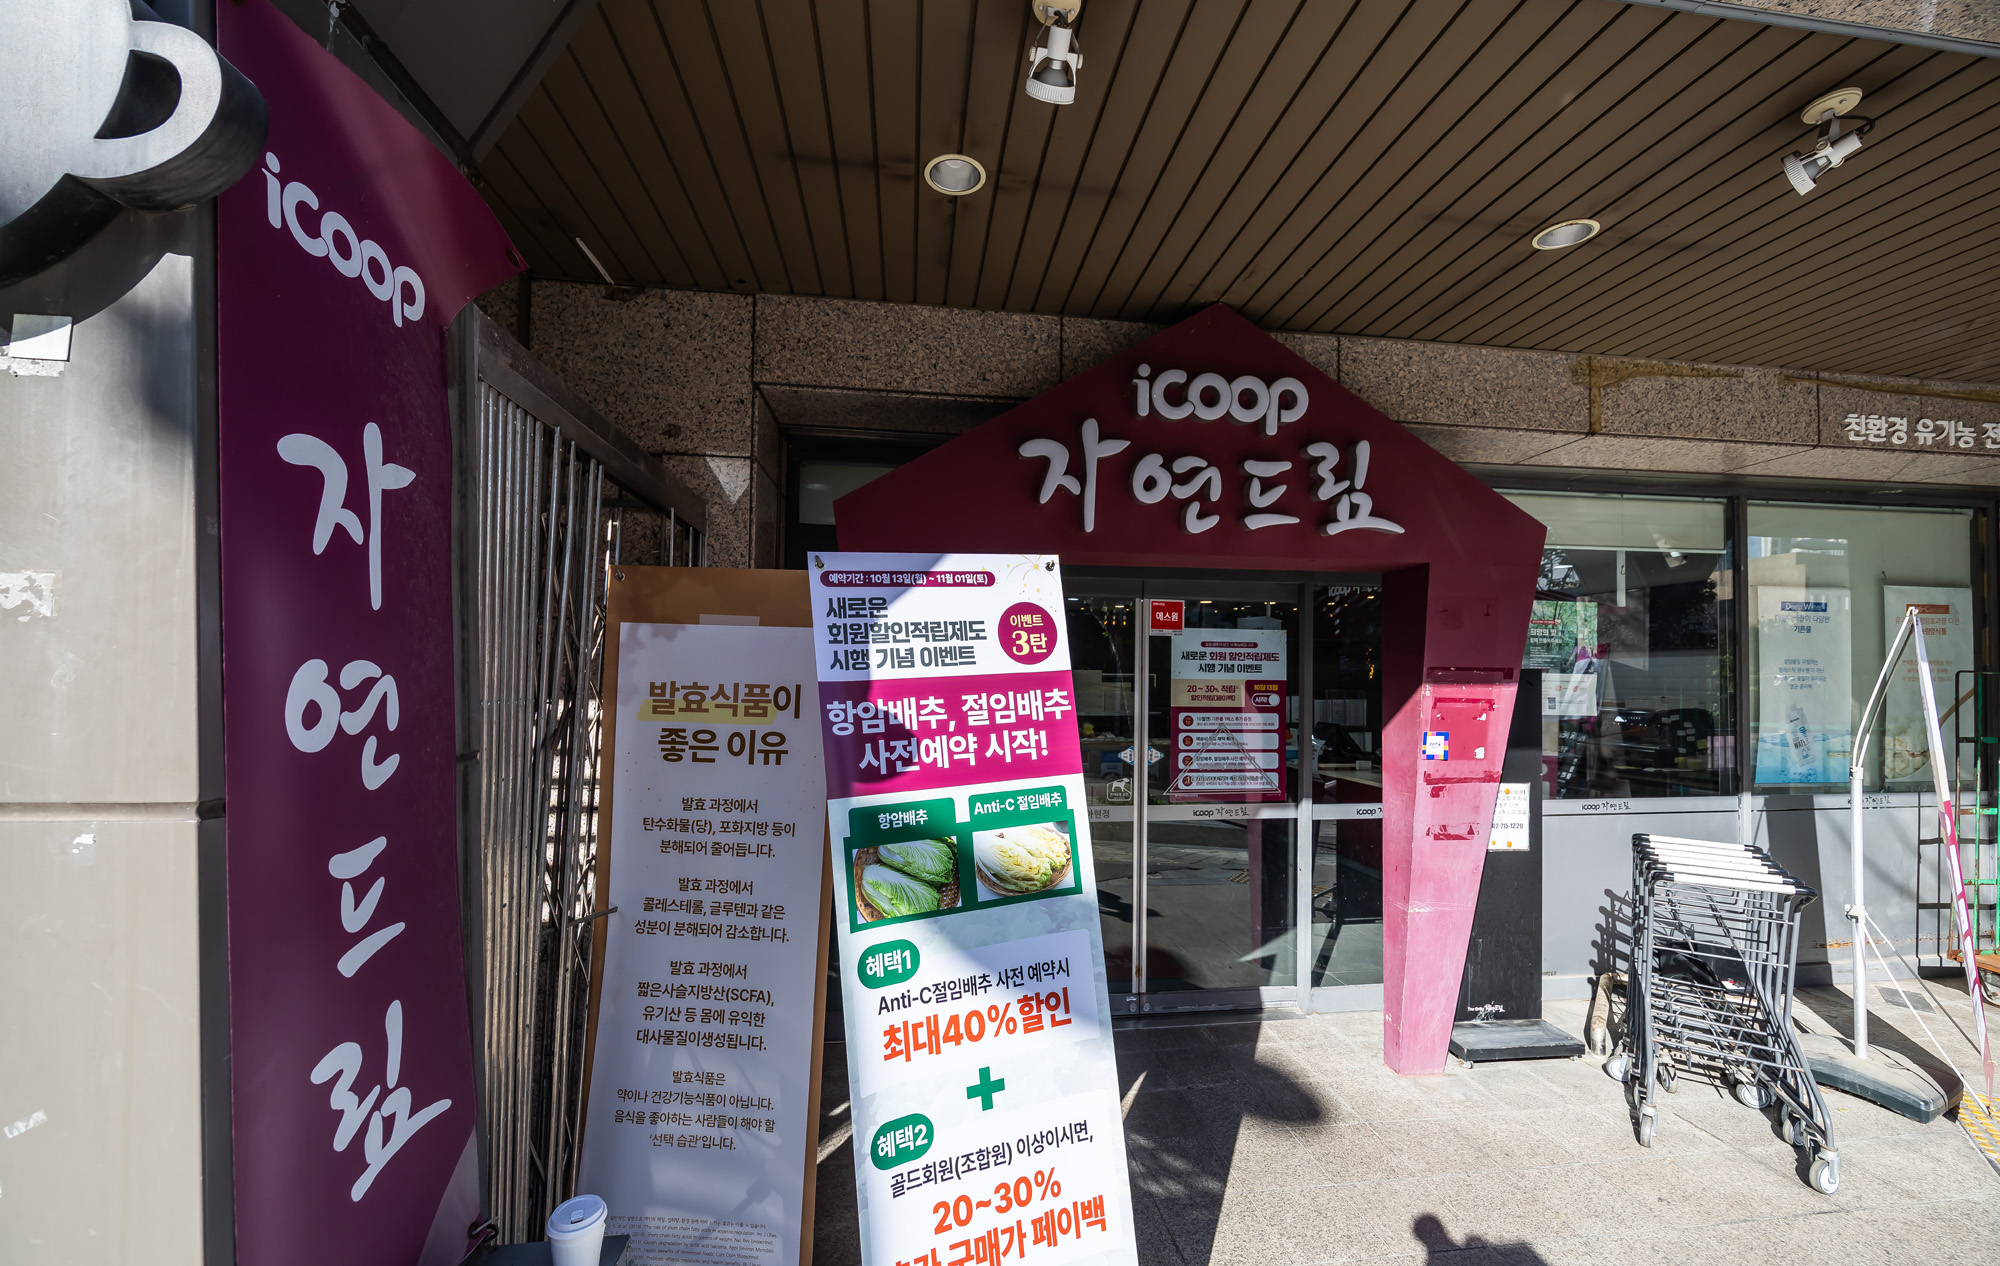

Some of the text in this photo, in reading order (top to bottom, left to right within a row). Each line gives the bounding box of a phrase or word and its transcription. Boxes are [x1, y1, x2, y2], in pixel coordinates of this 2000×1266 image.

[261, 151, 426, 328] icoop
[1132, 363, 1309, 436] icoop
[1844, 413, 1908, 445] 친환경
[1913, 418, 1977, 448] 유기농
[1018, 418, 1405, 536] 자연드림
[828, 573, 865, 584] 예약기간
[870, 574, 891, 584] 10월
[891, 573, 927, 585] 13일(월)
[936, 574, 954, 584] 11월
[954, 574, 988, 585] 01일(토)
[826, 596, 888, 620] 새로운
[1155, 611, 1179, 622] 에스원
[827, 620, 987, 645] 회원할인적립제도
[1009, 614, 1044, 628] 이벤트
[1012, 630, 1048, 656] 3탄
[830, 646, 977, 671] 시행 기념 이벤트
[1180, 651, 1280, 662] 새로운 회원 할인적립제도
[1198, 663, 1263, 673] 시행 기념 이벤트
[648, 681, 802, 719] 발효식품이
[826, 688, 1072, 736] 항암배추, 절임배추
[657, 727, 789, 766] 좋은 이유
[859, 727, 1049, 775] 사전예약 시작!
[277, 421, 452, 1203] 자연드림
[681, 797, 758, 814] 발효 과정에서
[973, 792, 1063, 815] Anti-C 절임배추
[1192, 806, 1250, 818] icoop 자연드림
[1356, 808, 1377, 816] icoop
[1581, 801, 1631, 811] icoop 자연드림
[642, 817, 796, 837] 탄수화물(당), 포화지방 등이
[878, 809, 928, 830] 항암배추
[659, 839, 776, 858] 분해되어 줄어듭니다.
[678, 877, 754, 895] 발효 과정에서
[642, 897, 785, 920] 콜레스테롤, 글루텐과 같은
[634, 919, 790, 943] 성분이 분해되어 감소합니다.
[670, 960, 748, 980] 발효 과정에서
[865, 949, 912, 979] 혜택1
[637, 981, 775, 1007] 짧은사슬지방산(SCFA),
[878, 957, 1070, 1015] Anti-C절임배추 사전 예약시
[642, 1005, 766, 1028] 유기산 등 몸에 유익한
[883, 987, 1072, 1062] 최대40%할인
[672, 1070, 726, 1086] 발효식품은
[616, 1088, 774, 1111] 약이나 건강기능식품이 아닙니다.
[614, 1110, 776, 1133] 음식을 좋아하는 사람들이 해야 할
[876, 1123, 928, 1159] 혜택2
[890, 1120, 1094, 1199] 골드회원(조합원) 이상이시면,
[932, 1167, 1062, 1236] 20~30%
[1031, 1195, 1107, 1248] 페이백
